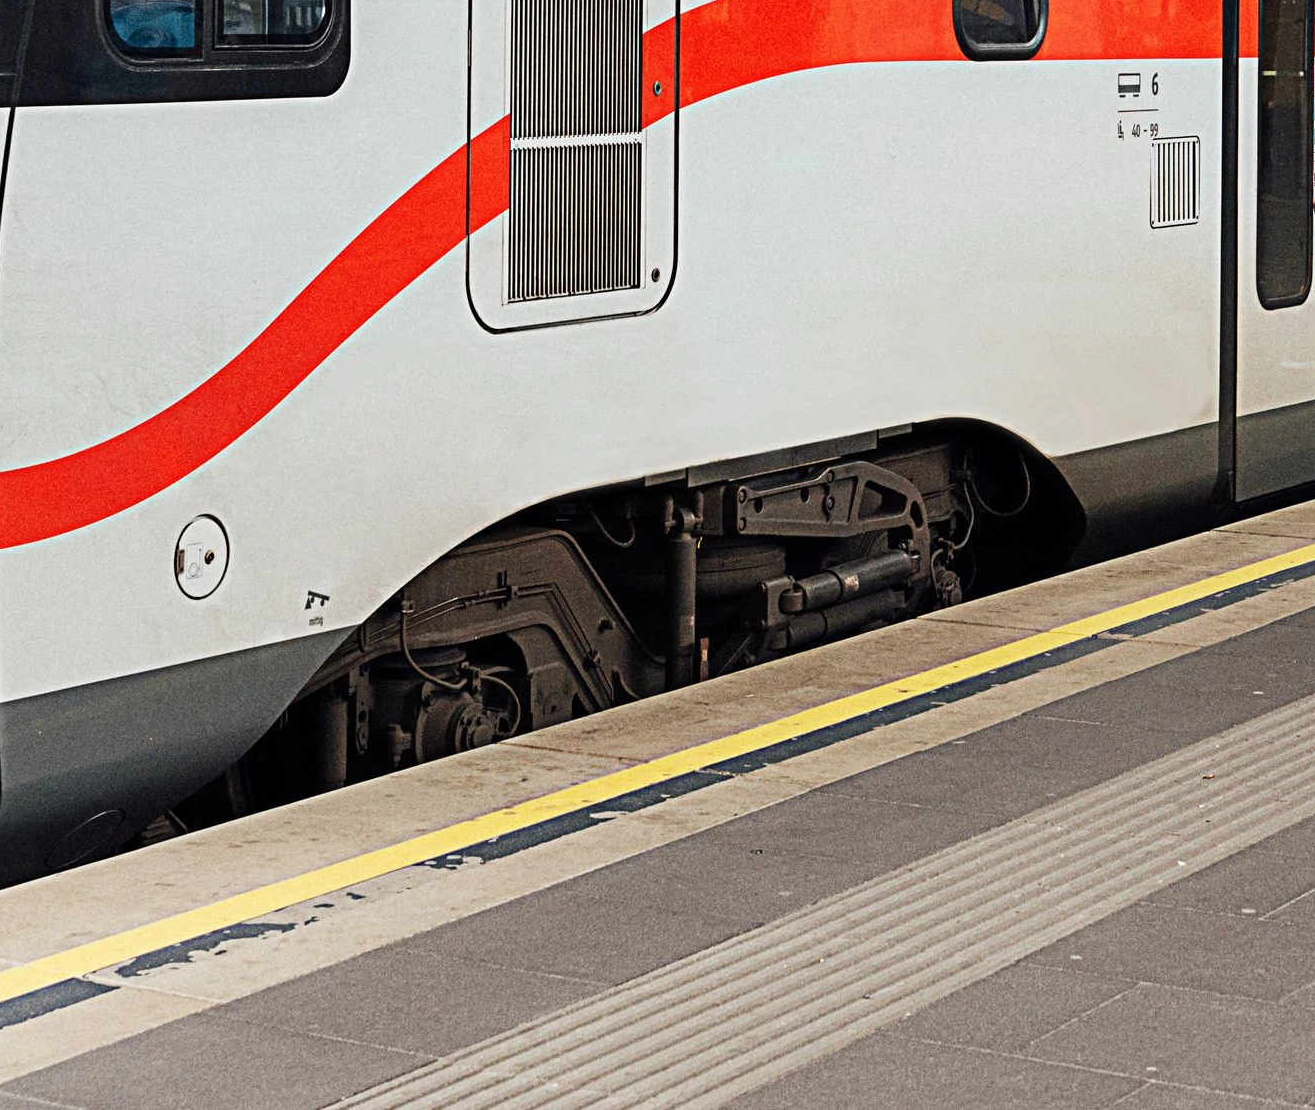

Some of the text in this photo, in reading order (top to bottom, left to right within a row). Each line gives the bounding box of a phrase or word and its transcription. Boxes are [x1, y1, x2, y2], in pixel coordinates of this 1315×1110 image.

[1152, 72, 1159, 96] 6
[1131, 123, 1141, 138] 40
[1150, 123, 1159, 137] 99
